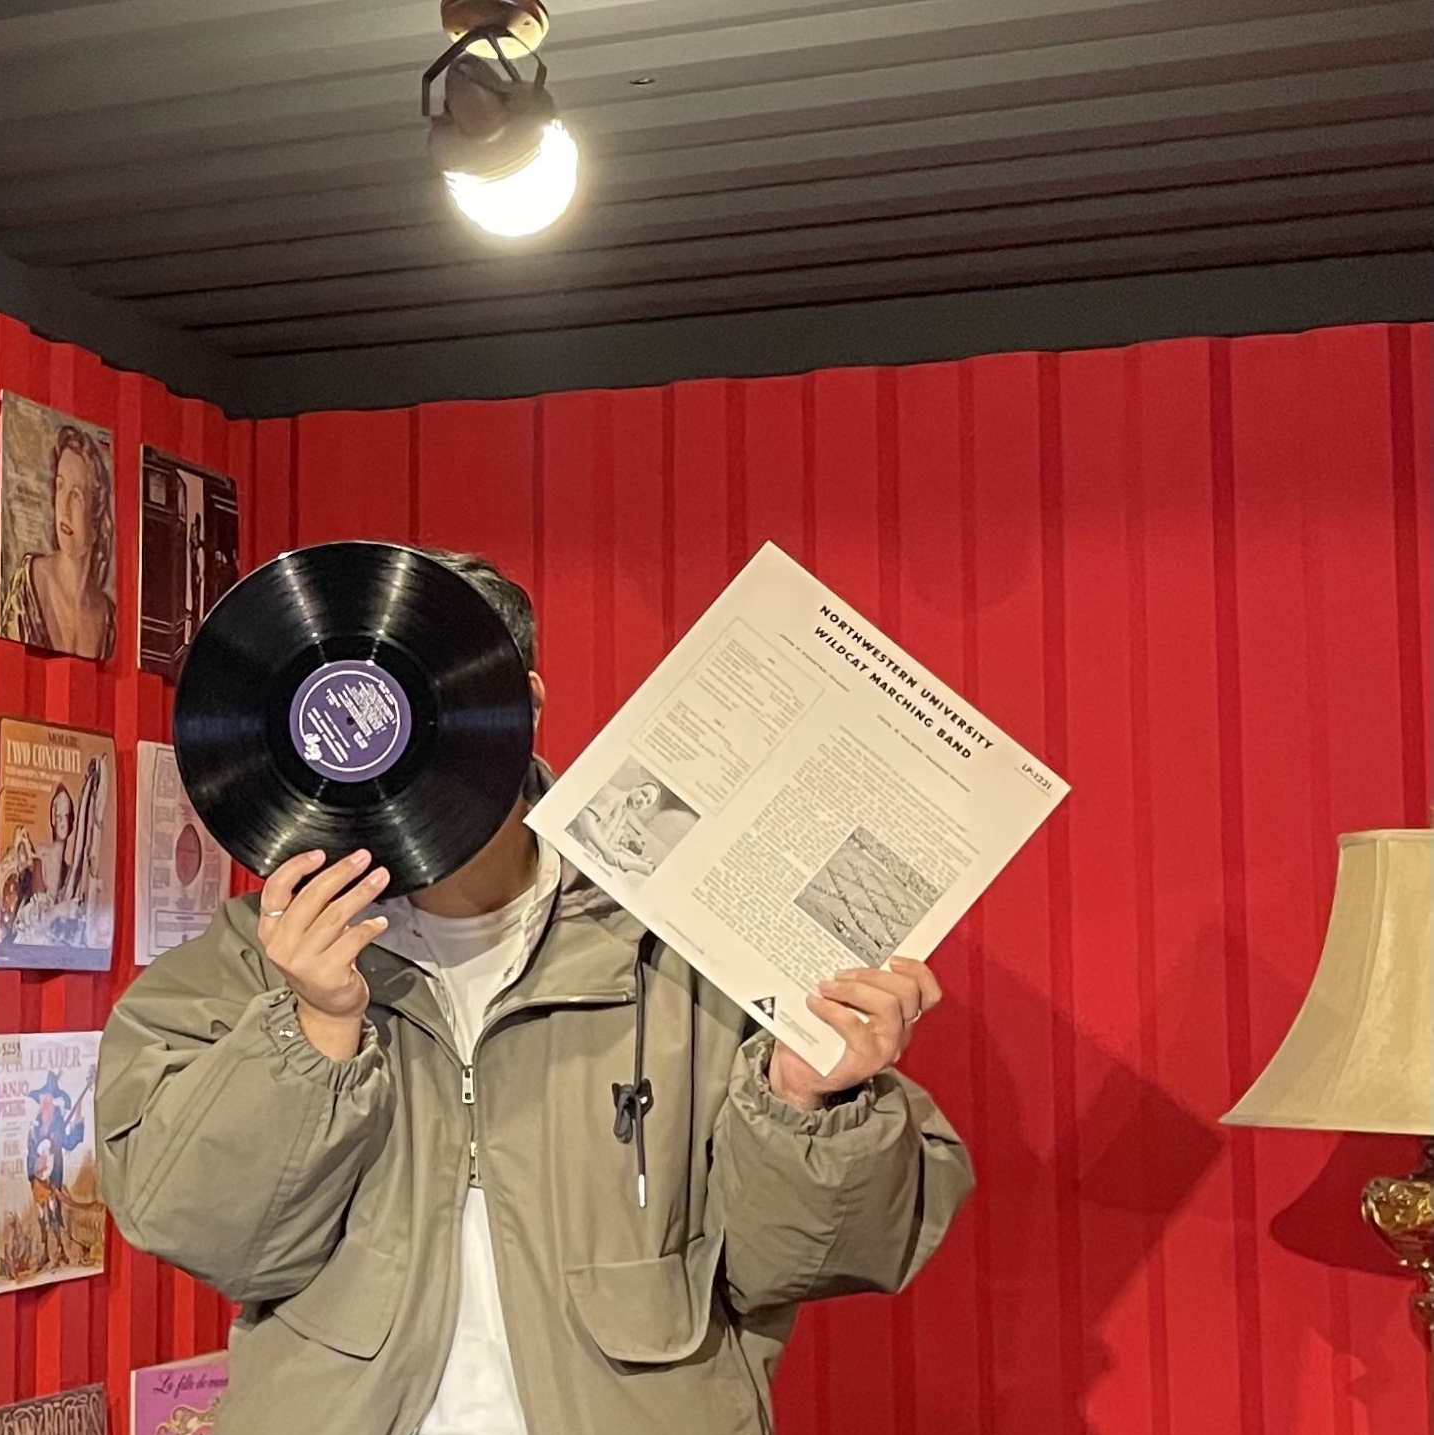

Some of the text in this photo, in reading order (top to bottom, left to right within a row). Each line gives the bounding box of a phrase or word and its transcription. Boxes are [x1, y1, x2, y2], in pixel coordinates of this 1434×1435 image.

[814, 626, 870, 673] WILDCAT
[869, 671, 934, 729] MARCHING
[936, 727, 972, 760] BAND
[819, 605, 918, 689] NORTHWESTERN
[920, 687, 994, 751] UNIVERSITY
[6, 738, 31, 767] TWO
